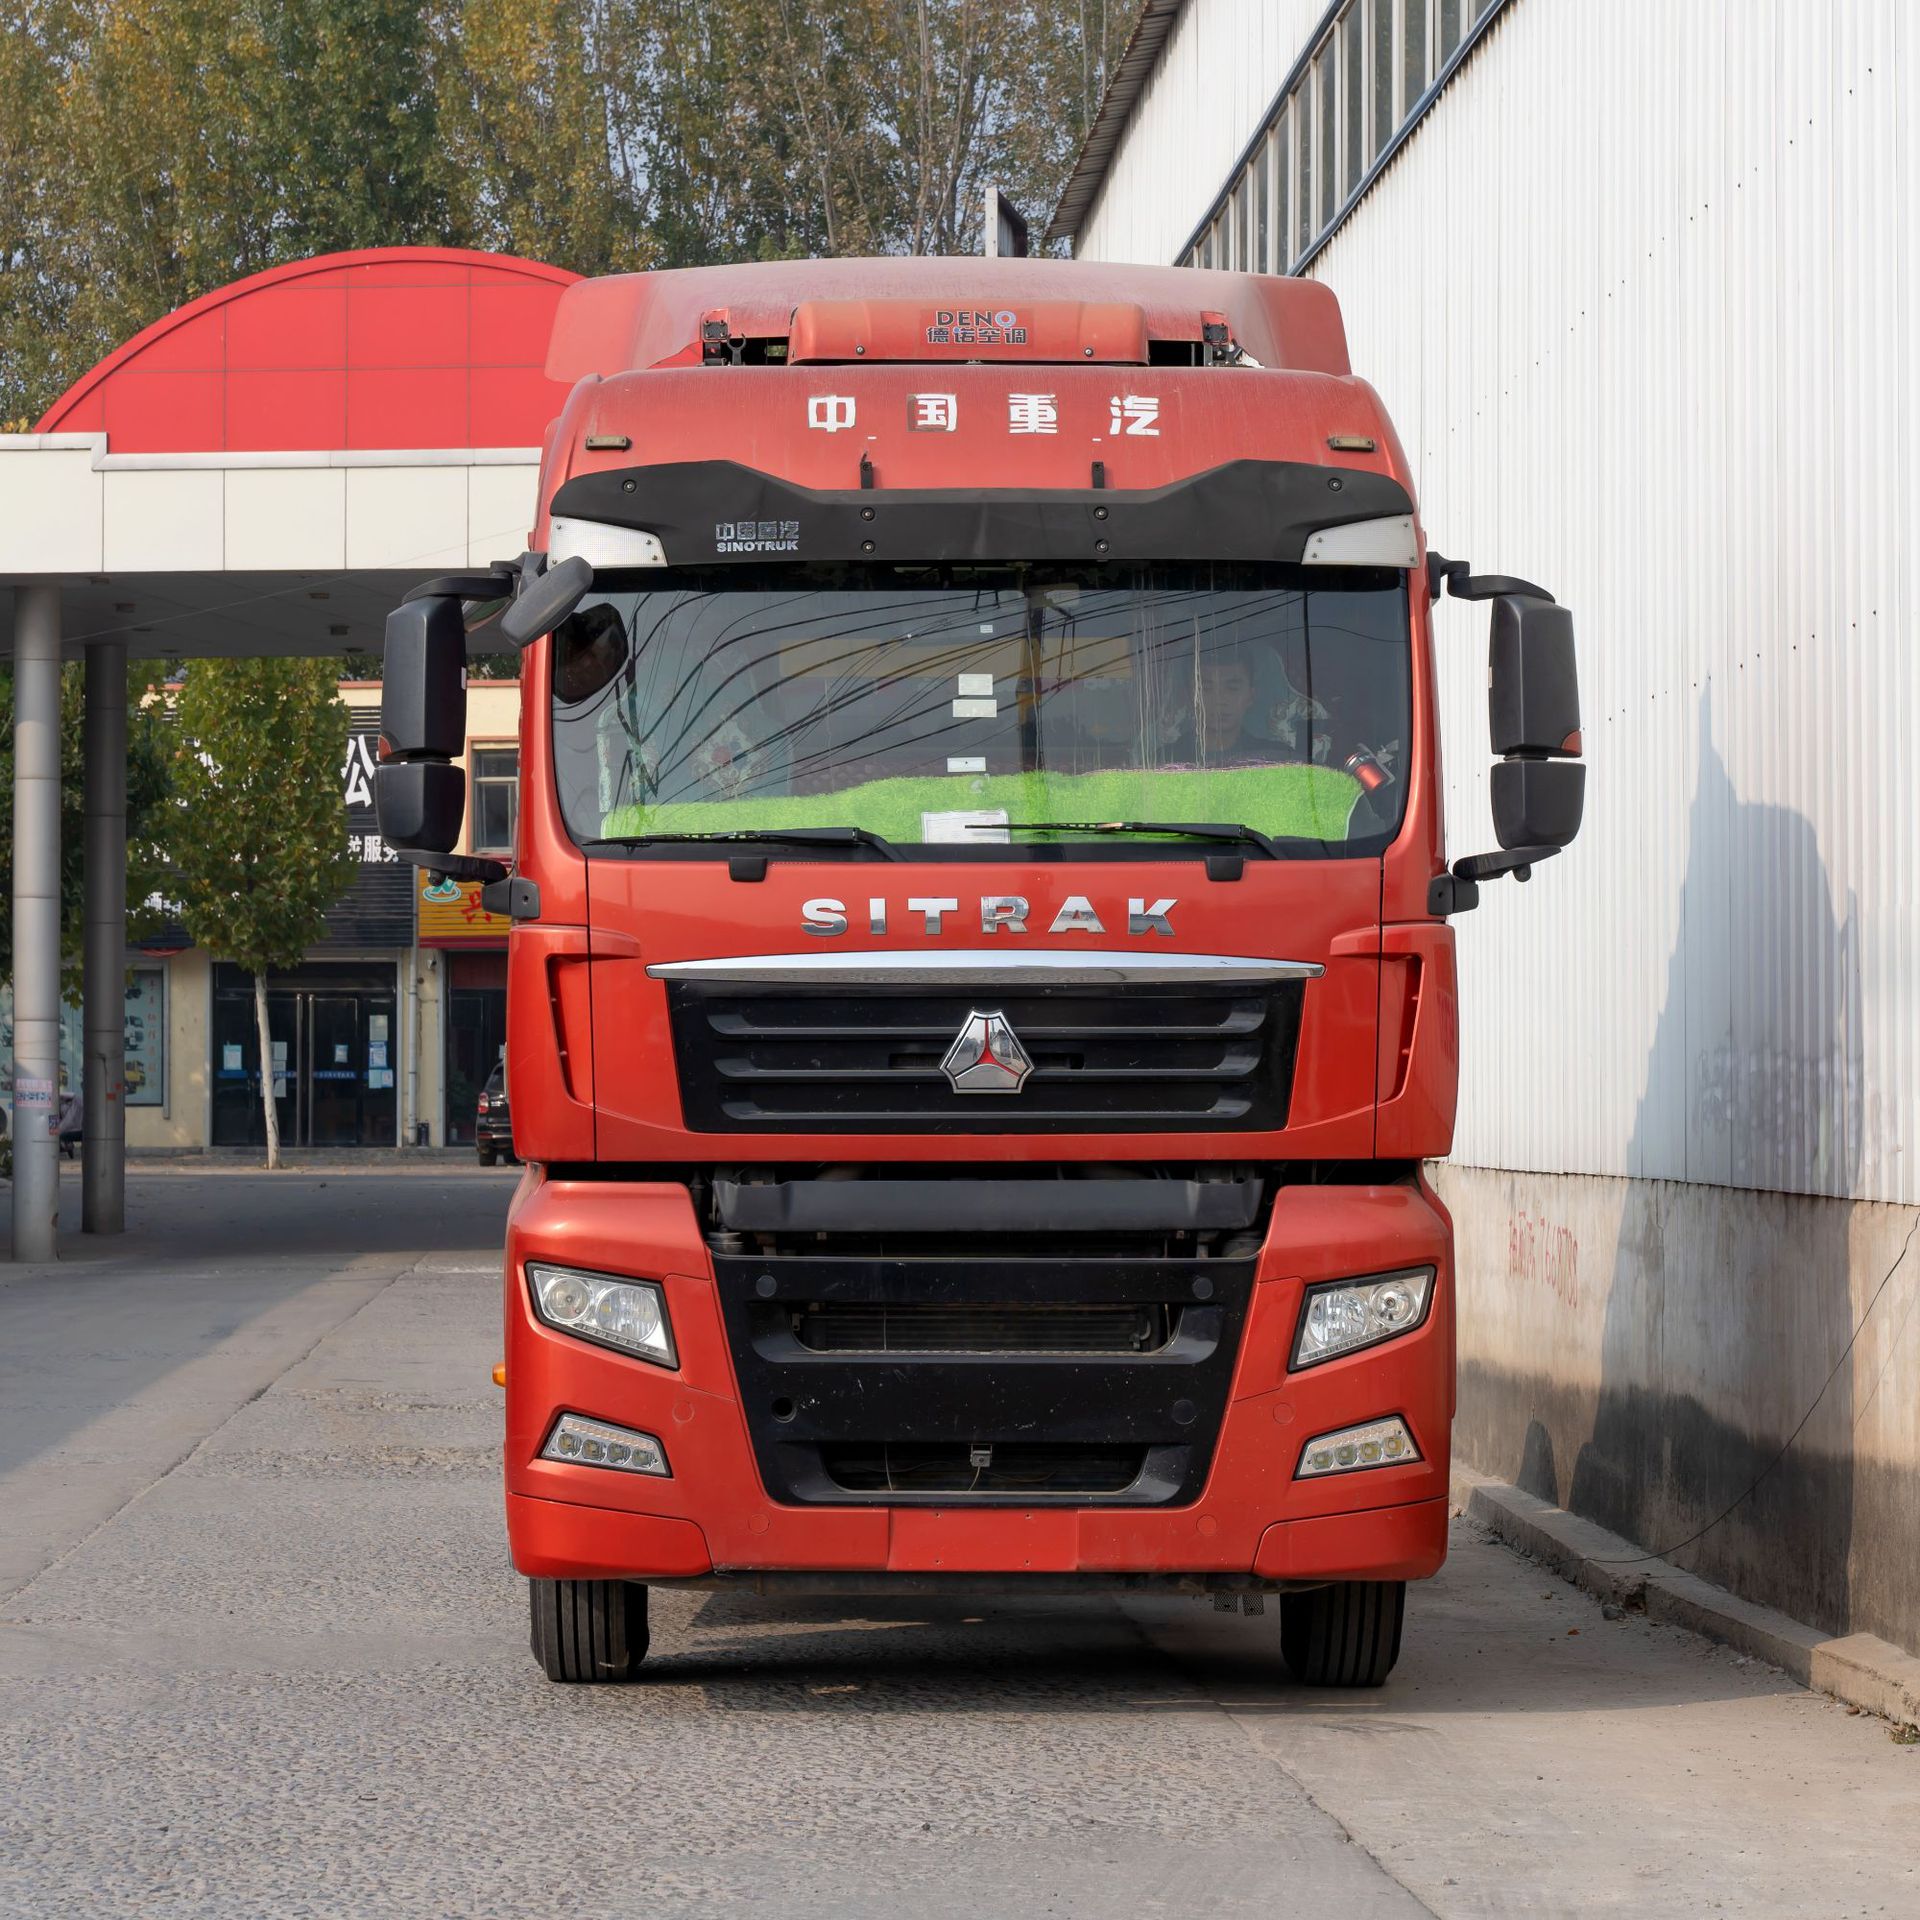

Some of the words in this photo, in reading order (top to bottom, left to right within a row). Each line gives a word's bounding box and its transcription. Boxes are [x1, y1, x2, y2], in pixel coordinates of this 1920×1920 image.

[936, 310, 1017, 328] DENO
[927, 327, 1028, 344] 德诺空调
[807, 393, 1161, 436] 中国重汽
[715, 521, 800, 541] 中国重汽
[716, 540, 799, 553] SINOTRUK
[800, 895, 1179, 937] SITRAK
